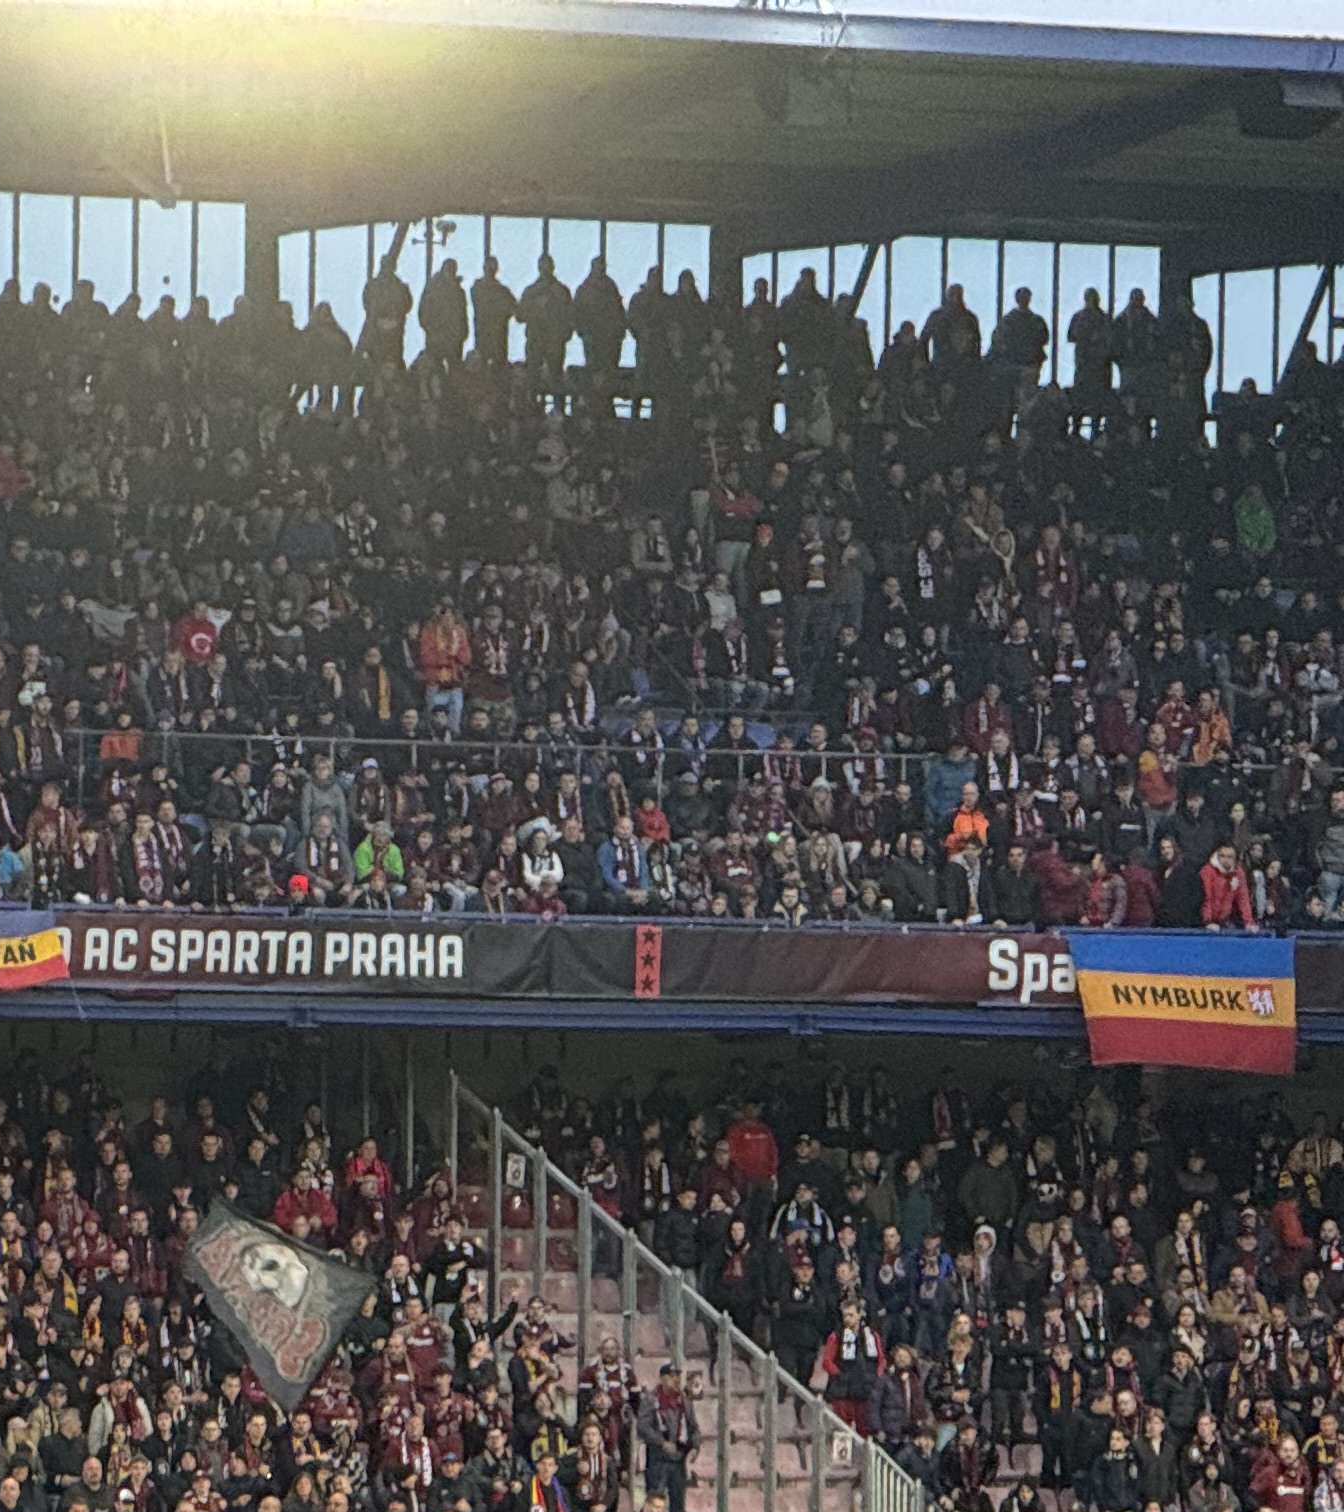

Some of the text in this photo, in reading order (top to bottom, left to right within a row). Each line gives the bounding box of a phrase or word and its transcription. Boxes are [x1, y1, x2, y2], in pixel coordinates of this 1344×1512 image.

[84, 928, 137, 971] AC
[150, 929, 311, 974] SPARTA
[324, 931, 464, 978] PRAHA
[1112, 982, 1244, 1012] NYMBURK
